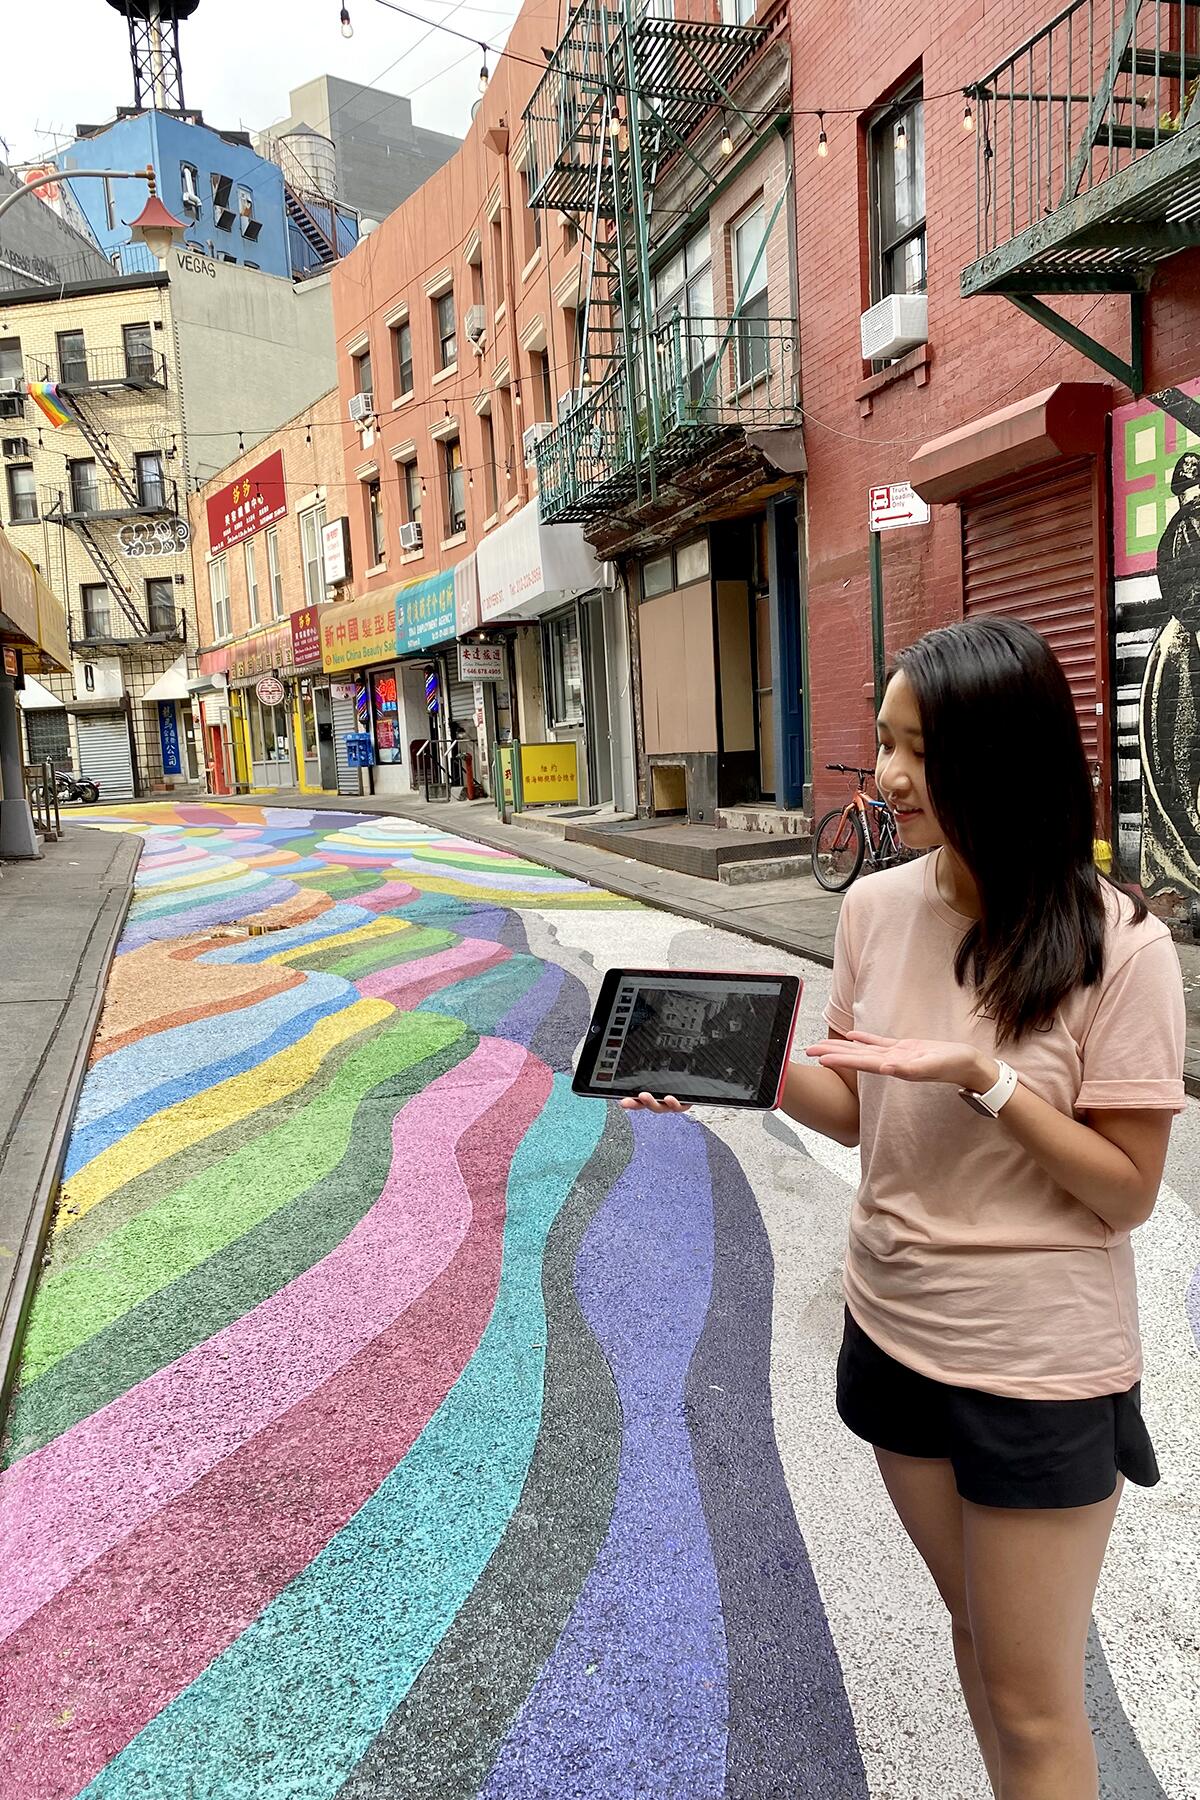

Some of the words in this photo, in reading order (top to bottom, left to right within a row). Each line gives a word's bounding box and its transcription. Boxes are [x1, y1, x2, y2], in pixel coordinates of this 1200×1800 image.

[177, 253, 216, 279] VEGAS
[892, 492, 914, 501] Loading
[333, 653, 345, 665] New
[346, 649, 361, 662] China
[362, 643, 382, 657] Beauty
[336, 685, 351, 693] ATM
